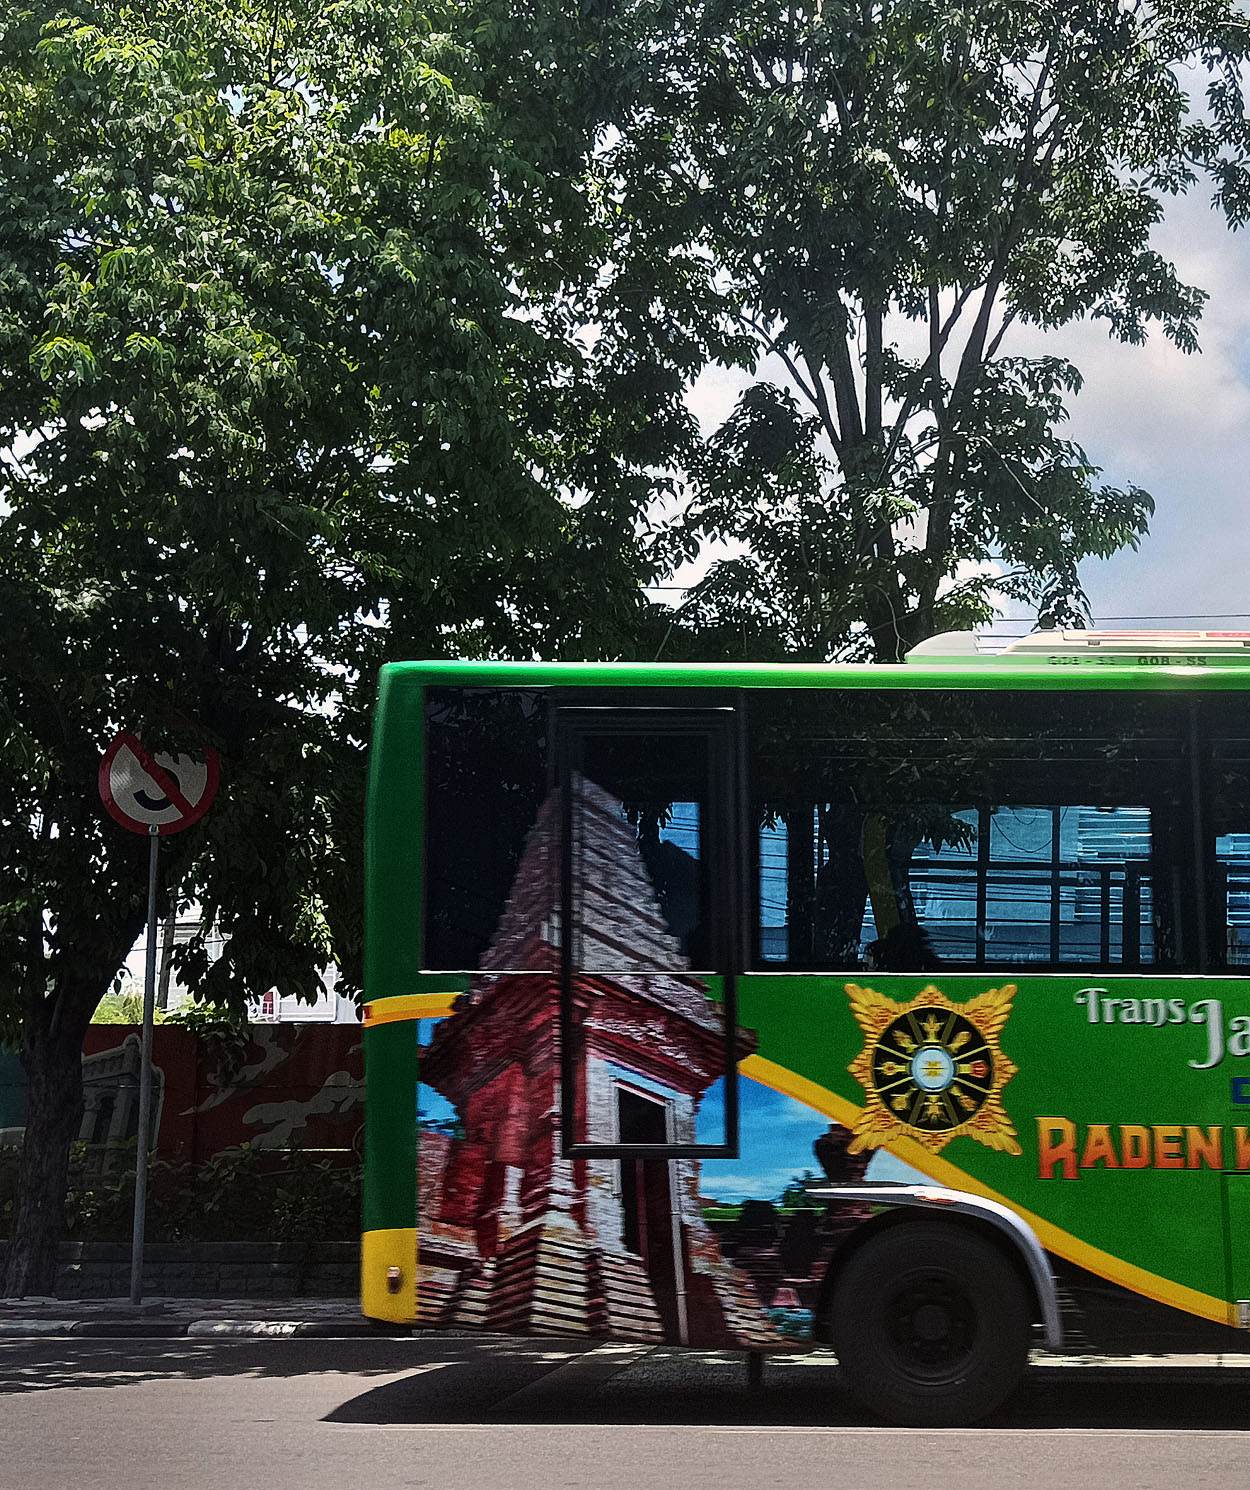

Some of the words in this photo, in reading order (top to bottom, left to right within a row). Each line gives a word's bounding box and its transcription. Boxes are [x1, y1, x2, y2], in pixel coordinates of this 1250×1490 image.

[1187, 655, 1207, 666] SS
[1074, 988, 1187, 1027] Trans
[1034, 1116, 1224, 1180] RADEN
